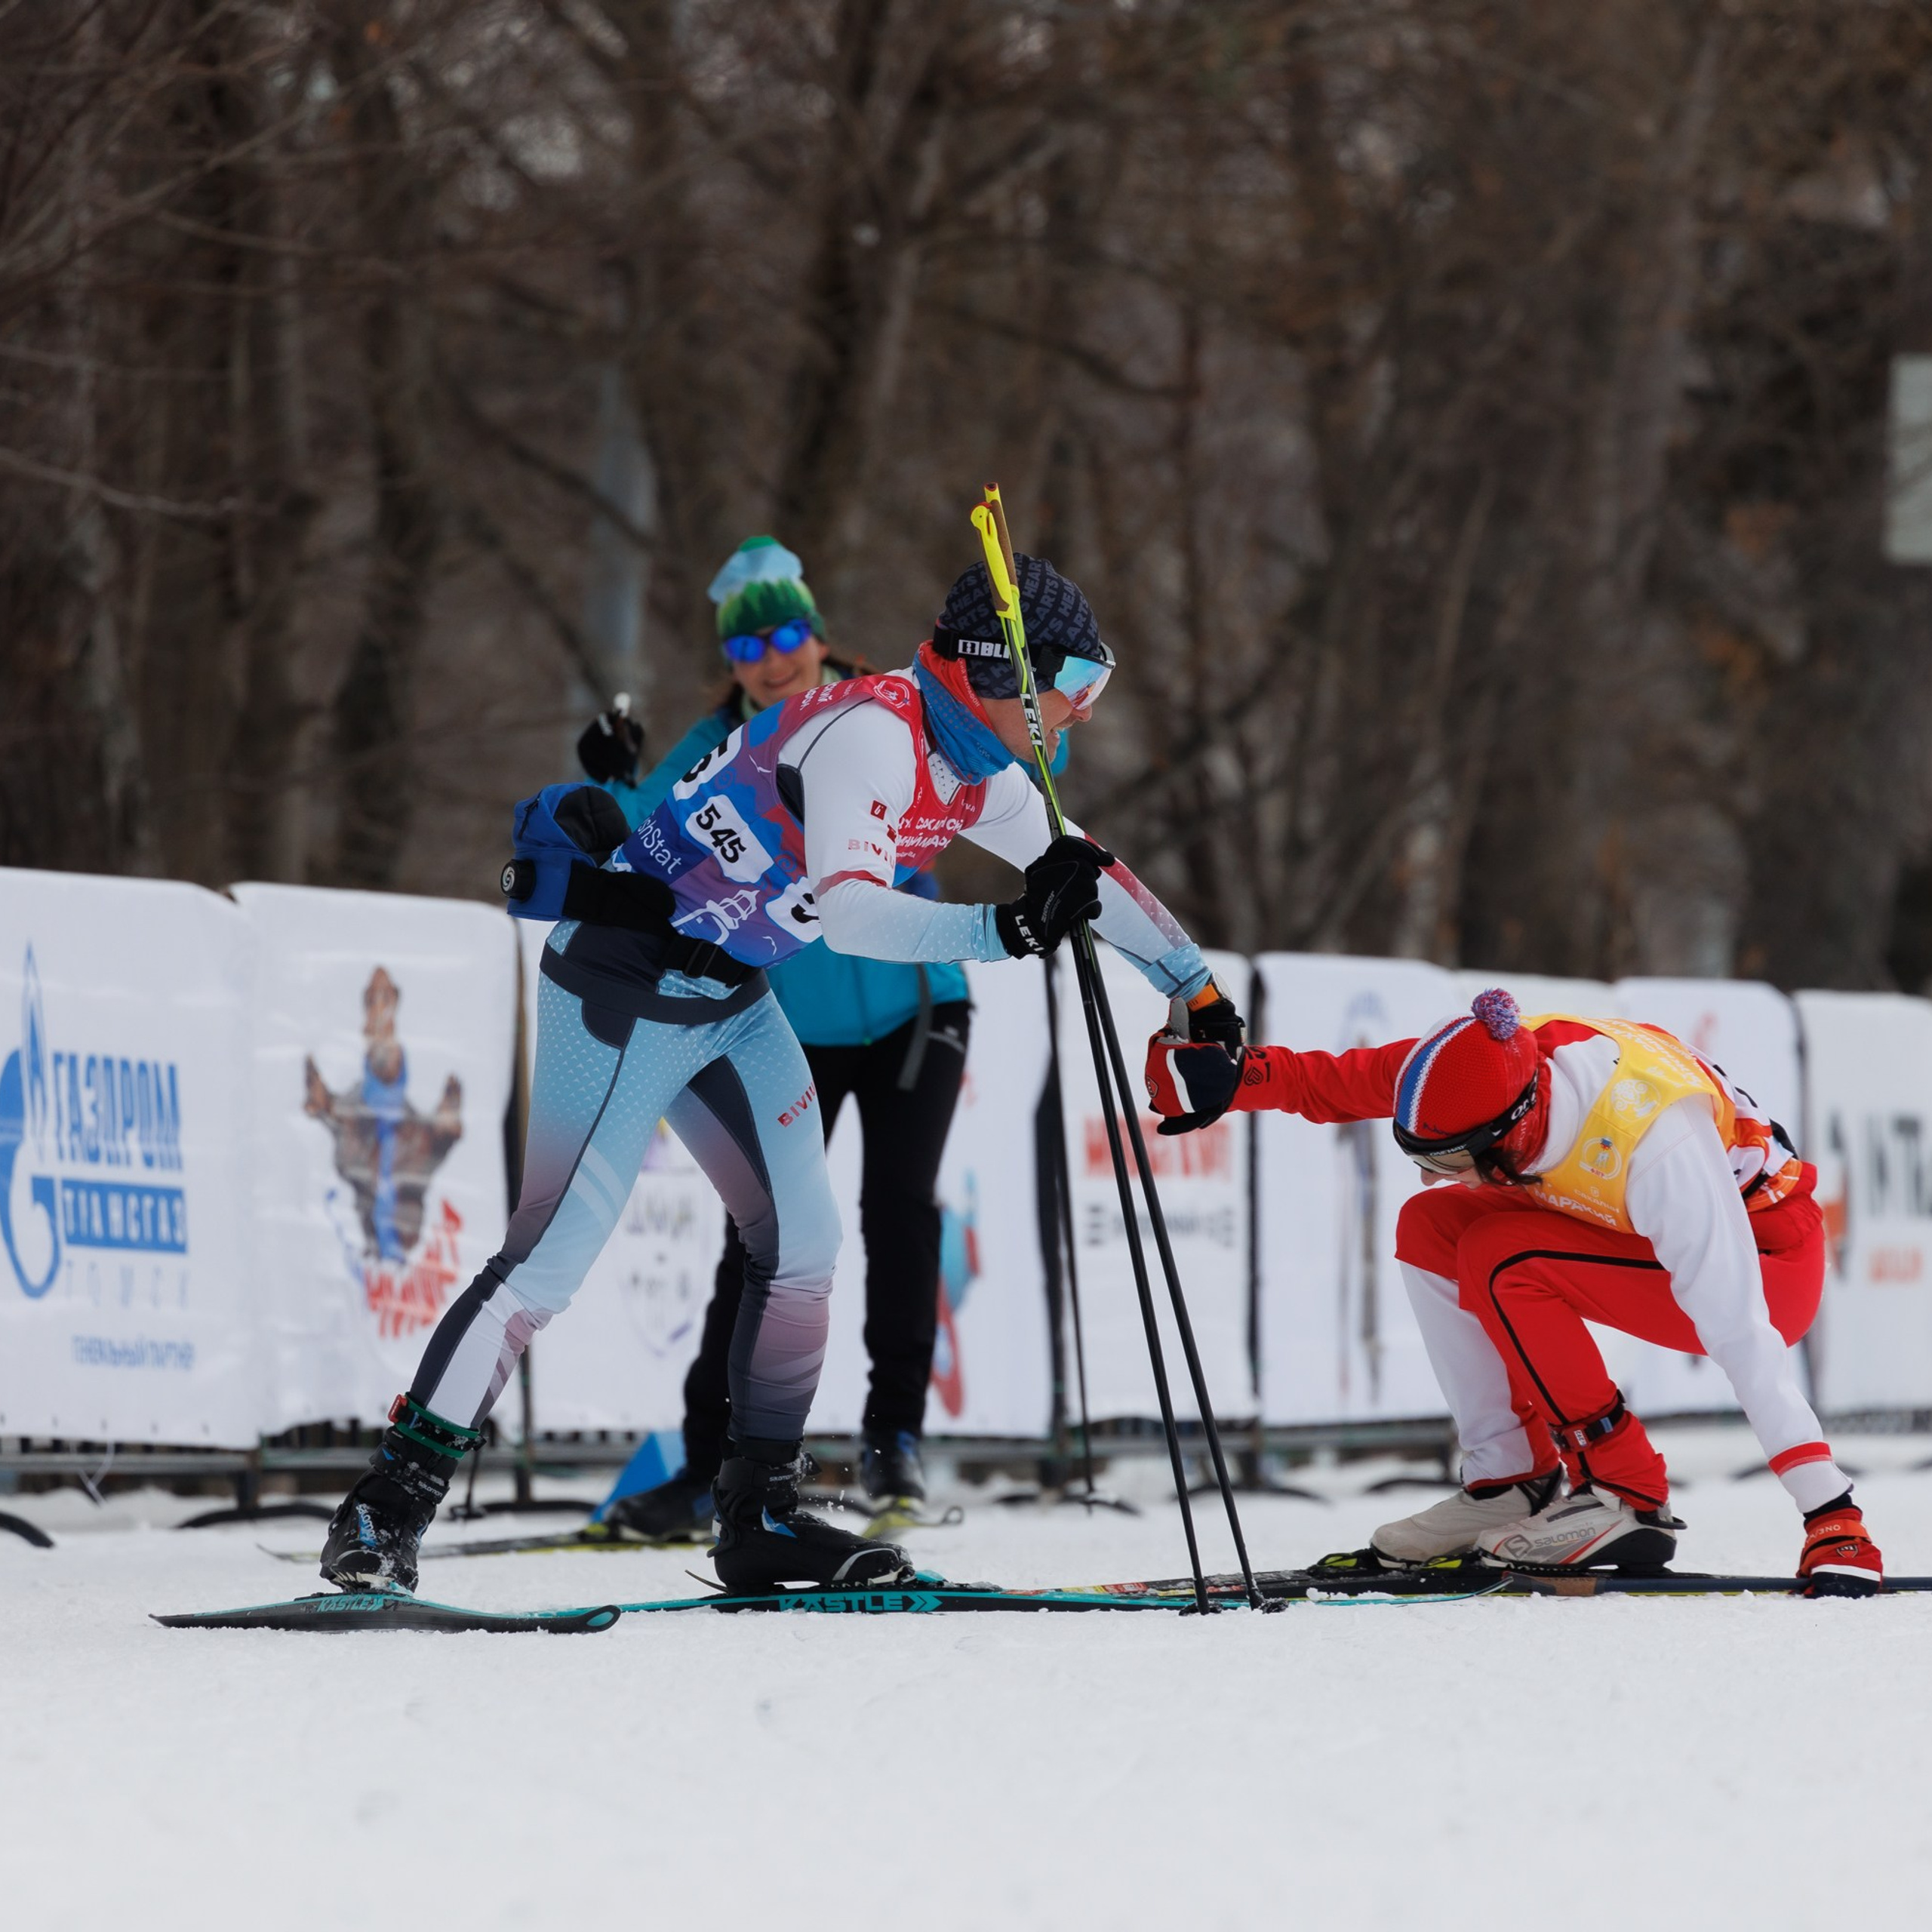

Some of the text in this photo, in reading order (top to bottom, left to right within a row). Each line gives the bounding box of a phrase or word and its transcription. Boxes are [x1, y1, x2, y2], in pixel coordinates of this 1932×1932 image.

[980, 641, 1010, 660] BLI
[1020, 693, 1043, 746] LEKI
[696, 803, 747, 864] 545
[1014, 914, 1045, 952] LEKI
[53, 1051, 183, 1171] ГАЗПРОМ
[418, 1480, 443, 1498] salomon
[1534, 1526, 1597, 1548] salomon
